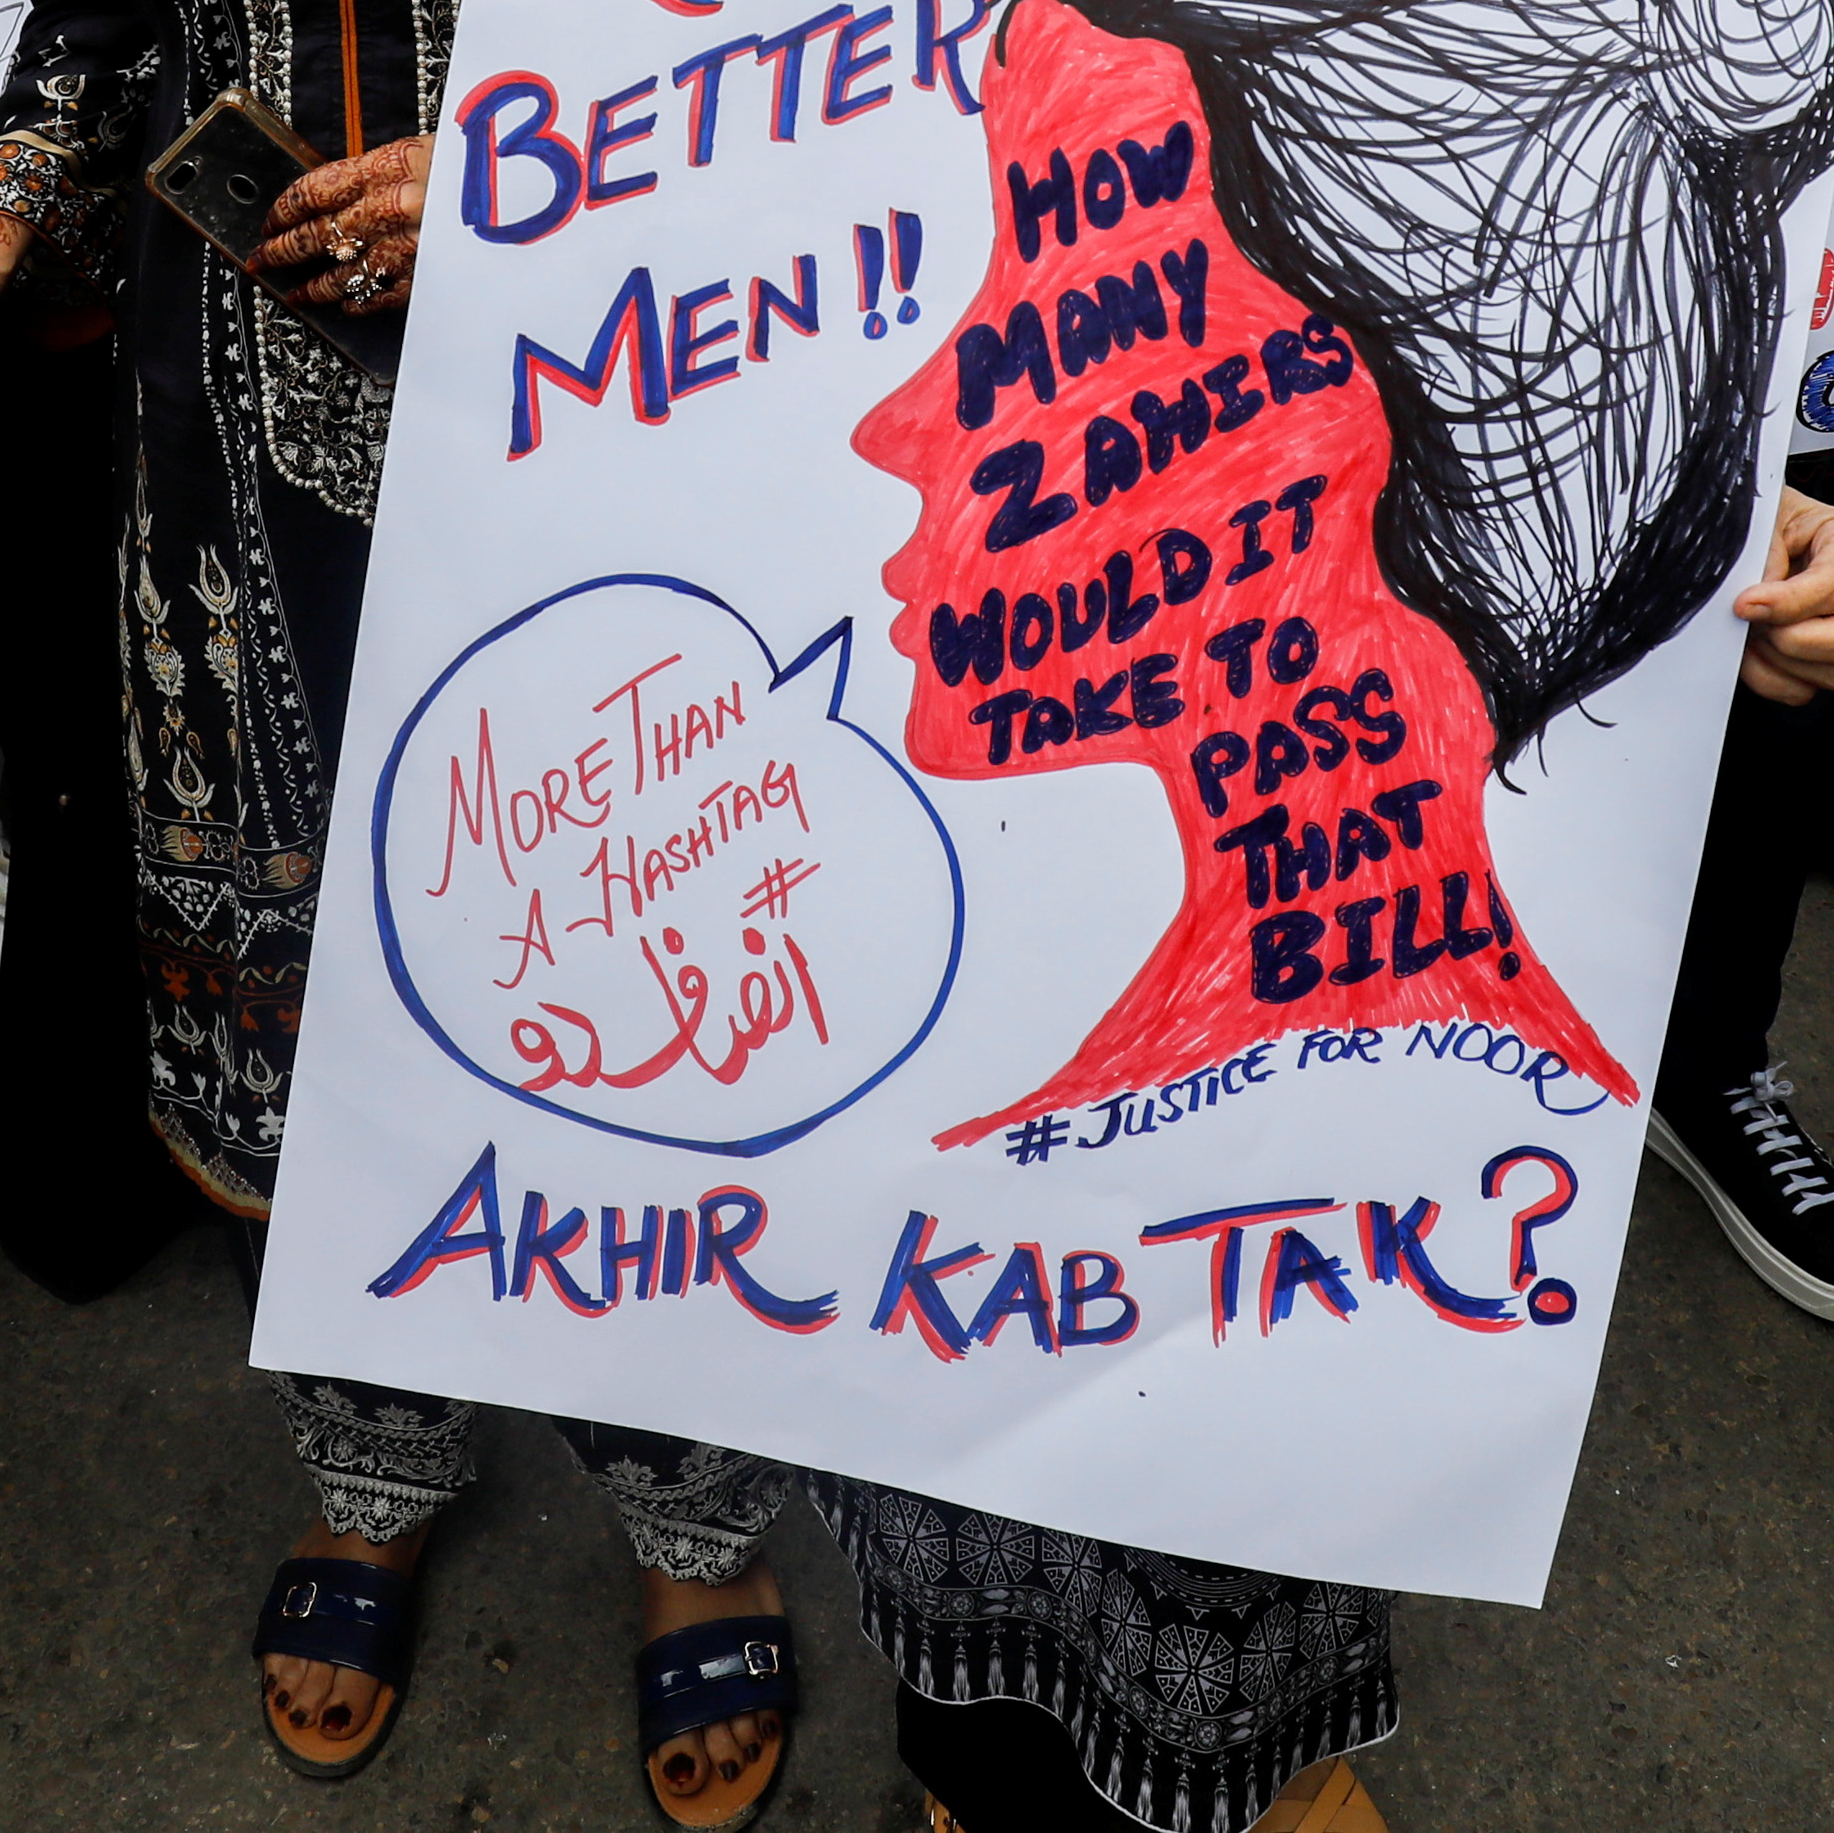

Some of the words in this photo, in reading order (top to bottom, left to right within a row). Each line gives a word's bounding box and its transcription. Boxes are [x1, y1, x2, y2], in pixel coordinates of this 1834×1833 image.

[1007, 120, 1194, 262] HOW
[954, 237, 1209, 432] MANY
[928, 526, 1213, 689] WOULD
[1223, 473, 1329, 586] IT
[968, 651, 1187, 765] TAKE
[1204, 614, 1320, 699] TO
[1189, 667, 1407, 818] PASS
[425, 707, 611, 896] MORE
[592, 652, 746, 797] THAN
[1215, 780, 1443, 911] THAT
[1248, 870, 1522, 1005] BILL!
[1295, 1026, 1384, 1071] FOR
[1404, 1019, 1611, 1117] NOOR
[366, 1140, 842, 1336] AKHIR
[870, 1208, 1140, 1365] KAB
[1138, 1144, 1580, 1350] TAK?
